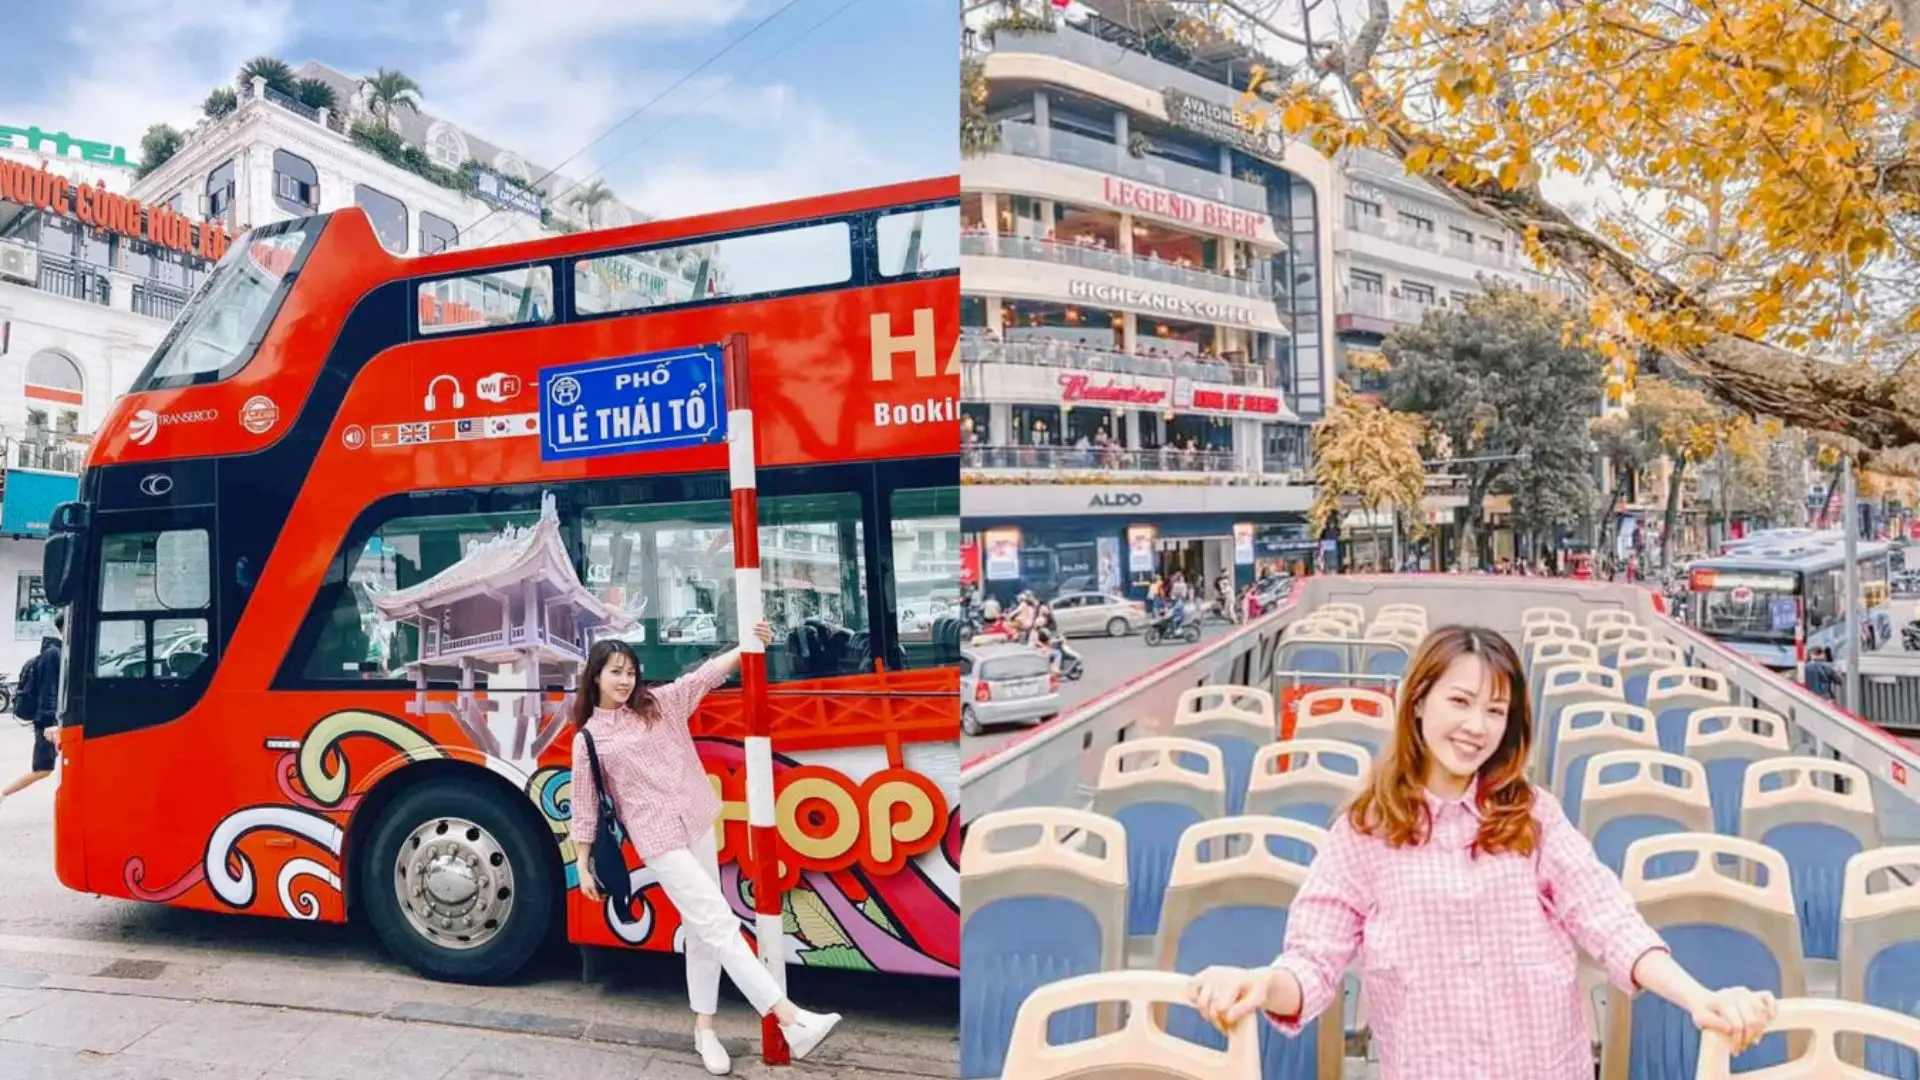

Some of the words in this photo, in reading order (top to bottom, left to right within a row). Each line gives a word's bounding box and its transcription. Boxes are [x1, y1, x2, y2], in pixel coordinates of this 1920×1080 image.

[0, 156, 69, 216] NƯỚC
[76, 178, 141, 238] CỘNG
[149, 203, 192, 251] HÒA
[1103, 176, 1195, 223] LEGEND
[1202, 202, 1257, 238] BEER
[1069, 279, 1193, 314] HIGHLANDS
[1194, 301, 1255, 323] COFFEE
[871, 309, 960, 380] H
[614, 360, 674, 390] PHỐ
[159, 409, 218, 425] TRANSERCO
[557, 405, 590, 445] LÊ
[596, 392, 661, 440] THÁI
[667, 382, 708, 430] TỔ
[874, 397, 960, 427] Booki
[1089, 493, 1142, 507] ALDO
